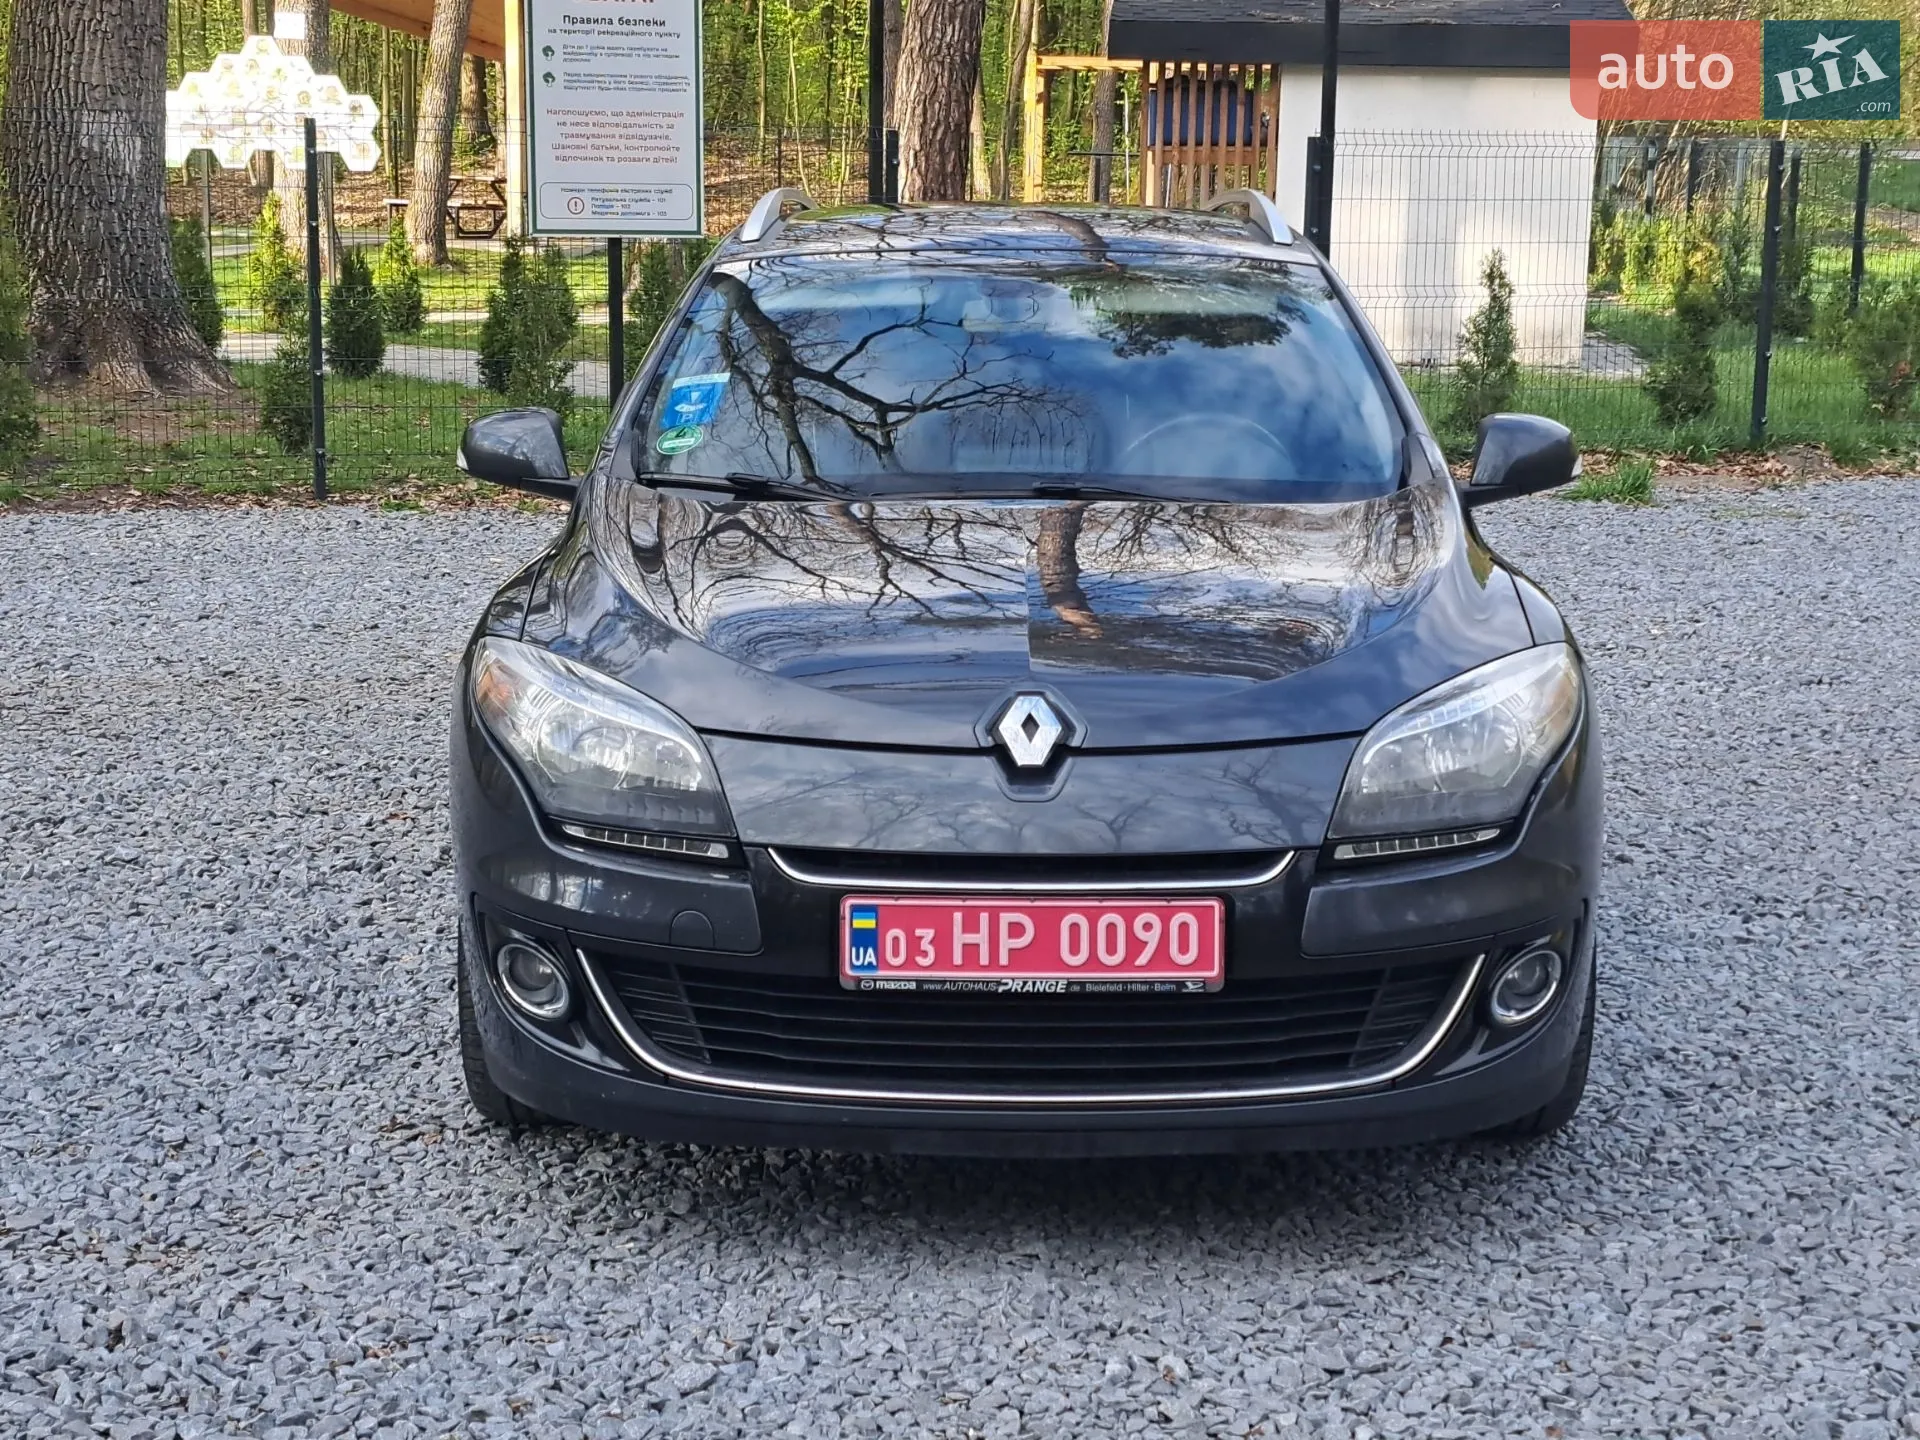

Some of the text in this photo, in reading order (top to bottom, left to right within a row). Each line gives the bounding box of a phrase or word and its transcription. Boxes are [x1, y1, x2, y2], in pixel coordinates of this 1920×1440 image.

[563, 14, 666, 27] Правила безпеки
[559, 28, 596, 37] території
[597, 29, 653, 38] рекреаційного
[654, 31, 681, 39] пункту
[546, 108, 685, 119] Наголошуємо, що адміністрація
[592, 121, 664, 130] відповідальність
[560, 132, 672, 142] травмування відвідувачів.
[551, 142, 681, 152] Шановні батьки, контролюйте
[555, 154, 604, 163] відпочинок
[617, 156, 651, 164] розваги
[652, 156, 678, 164] дітей!
[884, 911, 1200, 968] 03 HP 0090
[850, 946, 878, 968] UA
